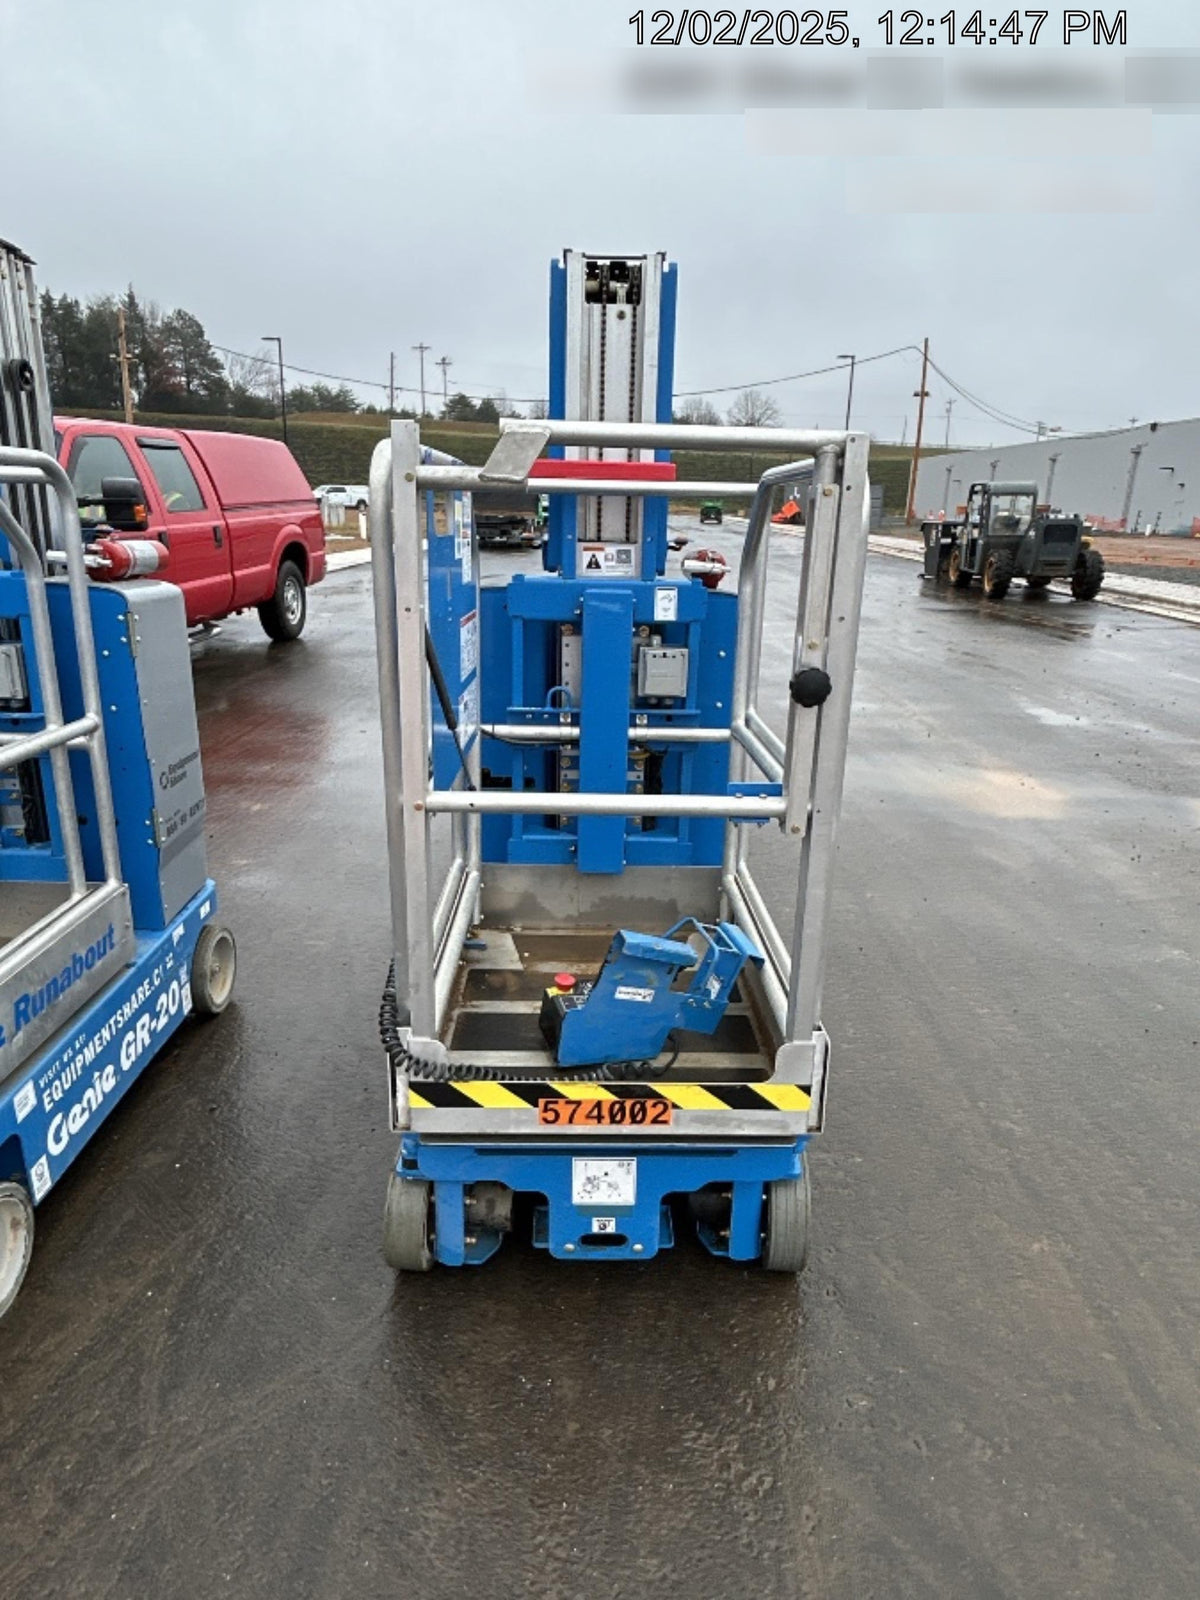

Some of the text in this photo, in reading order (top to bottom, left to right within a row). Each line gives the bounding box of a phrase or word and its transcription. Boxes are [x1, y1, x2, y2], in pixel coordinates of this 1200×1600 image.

[14, 922, 114, 1033] Runabout
[43, 952, 173, 1113] EQUIPMENTSHARE.C
[47, 979, 180, 1156] Genie GR-20
[541, 1100, 670, 1125] 574002
